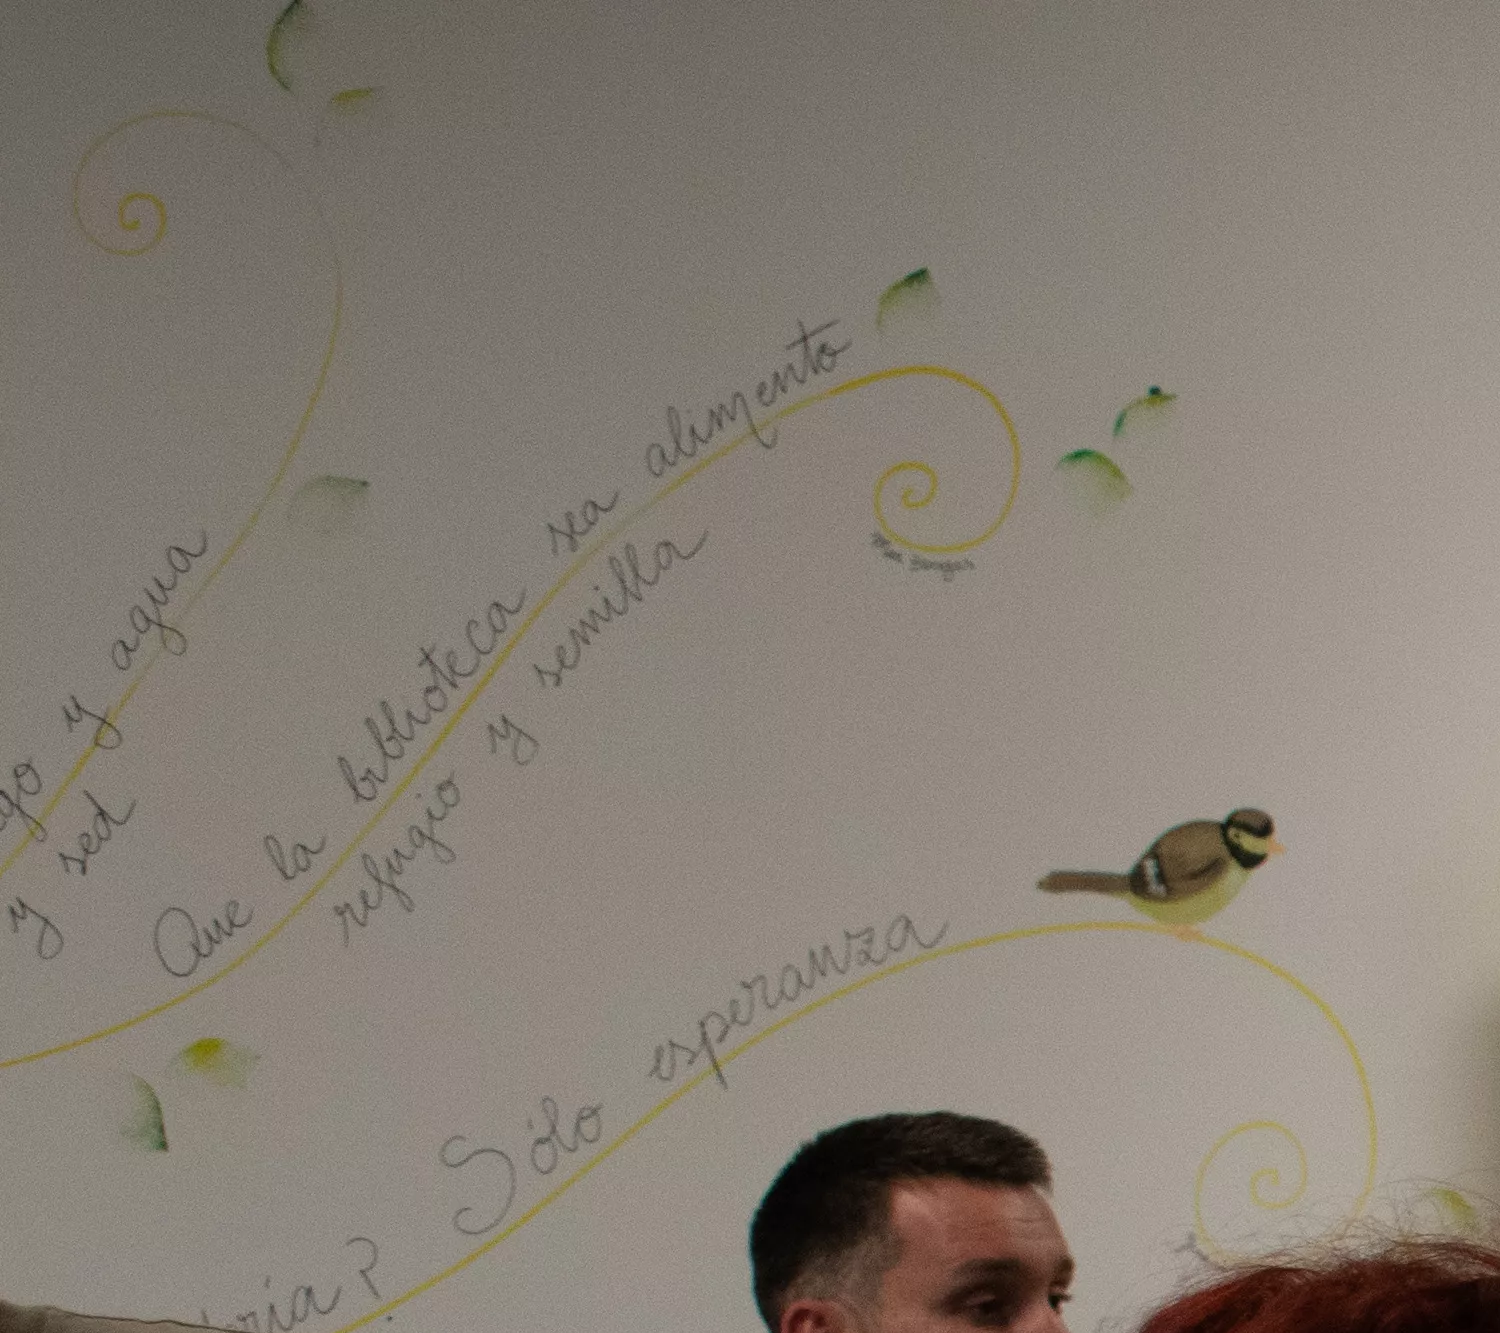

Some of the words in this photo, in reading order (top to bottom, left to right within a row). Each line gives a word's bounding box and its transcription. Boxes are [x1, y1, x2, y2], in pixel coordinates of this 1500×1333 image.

[0, 757, 42, 843] go
[62, 695, 123, 750] y
[111, 530, 207, 671] agua
[154, 900, 254, 977] Que
[263, 834, 328, 883] la
[337, 587, 527, 805] biblioteca
[546, 489, 621, 557] sea
[645, 318, 853, 479] alimento
[333, 770, 461, 948] refugio
[489, 713, 541, 768] y
[532, 529, 709, 689] semilla
[7, 896, 64, 960] y
[58, 790, 137, 876] sed
[648, 911, 950, 1091] esperanza
